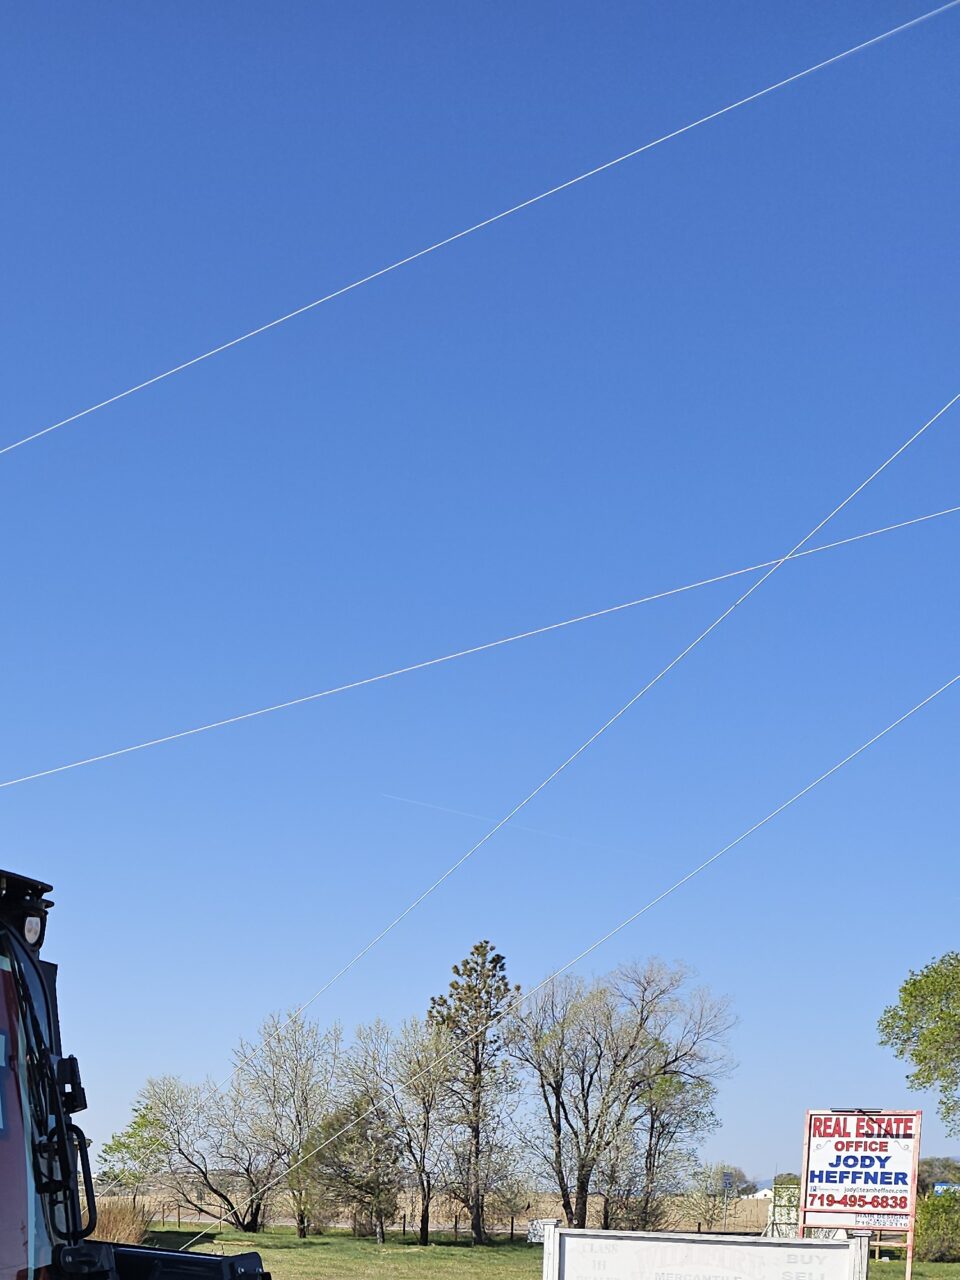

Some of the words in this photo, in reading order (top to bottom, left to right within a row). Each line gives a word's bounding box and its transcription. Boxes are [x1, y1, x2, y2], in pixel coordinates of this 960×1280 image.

[812, 1117, 851, 1138] REAL
[855, 1117, 914, 1139] ESTATE
[834, 1140, 889, 1152] OFFICE
[828, 1155, 892, 1169] JODY
[809, 1170, 908, 1185] HEFFNER
[808, 1193, 908, 1209] 719-495-6838
[786, 1254, 829, 1265] BUY
